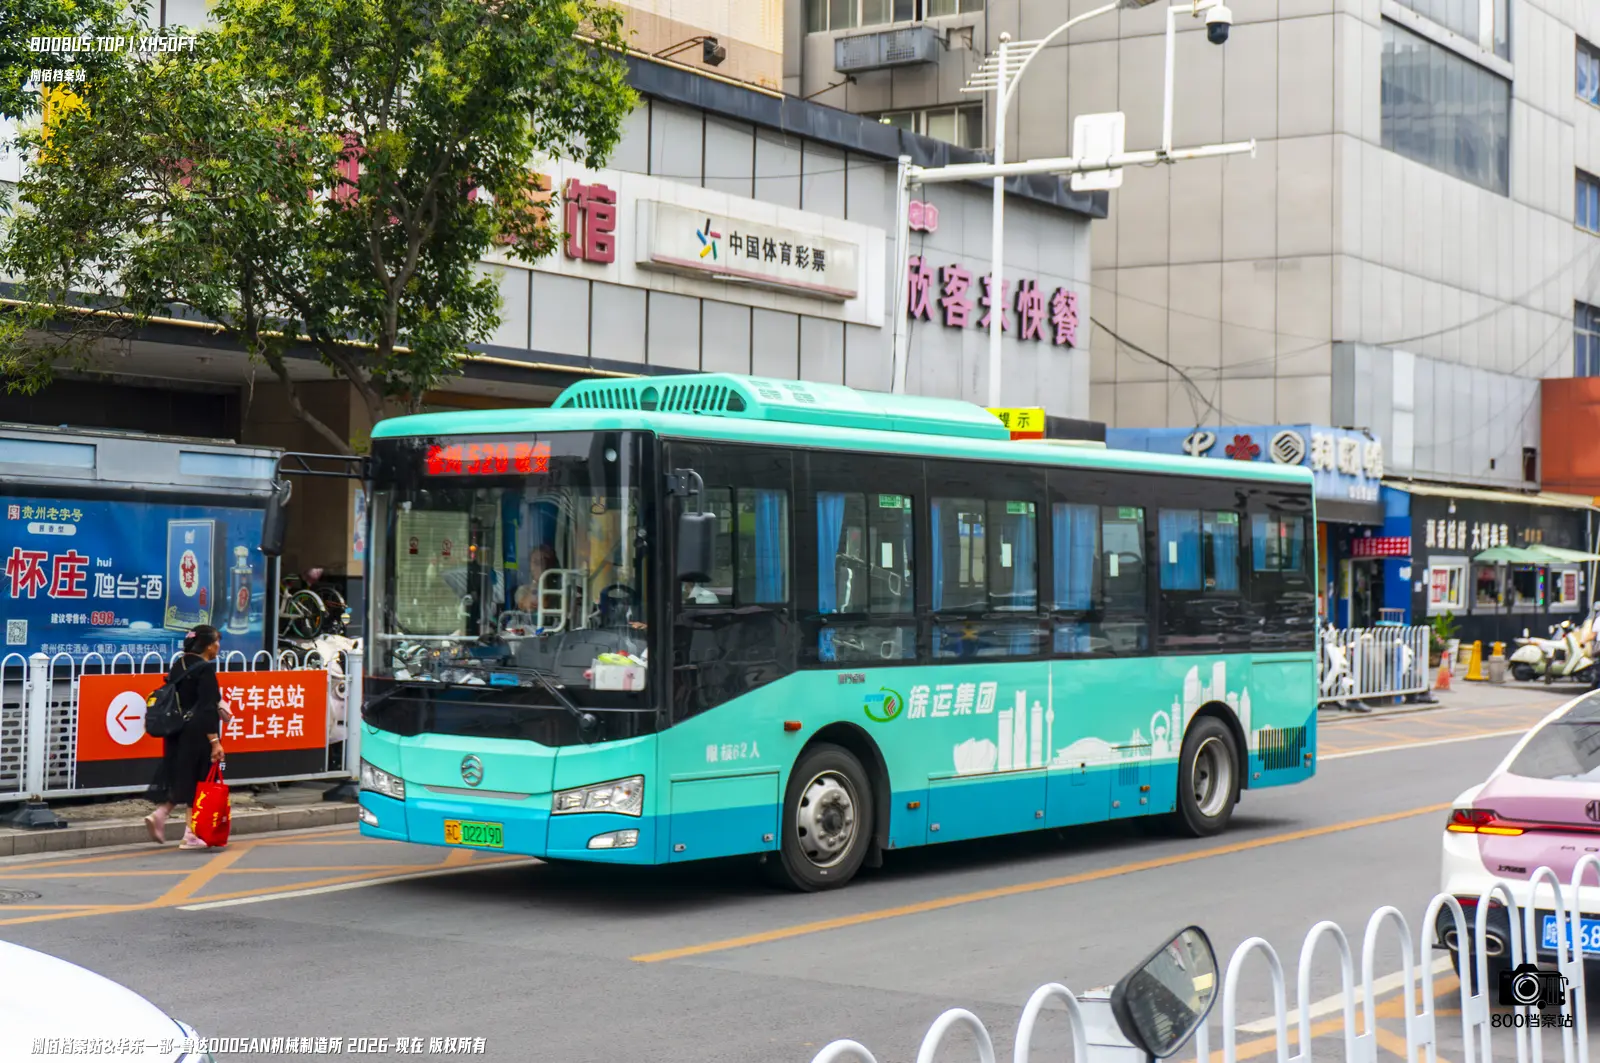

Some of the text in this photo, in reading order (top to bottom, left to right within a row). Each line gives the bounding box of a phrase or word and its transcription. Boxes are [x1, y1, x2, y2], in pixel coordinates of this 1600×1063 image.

[562, 177, 617, 264] 馆
[729, 230, 826, 272] 中国体育彩票
[21, 505, 84, 523] 贵州老字号
[5, 547, 90, 599] 怀庄
[96, 557, 113, 568] hui
[219, 684, 305, 711] 汽车总站
[907, 681, 998, 719] 徐运集团
[219, 713, 304, 741] 车上车点
